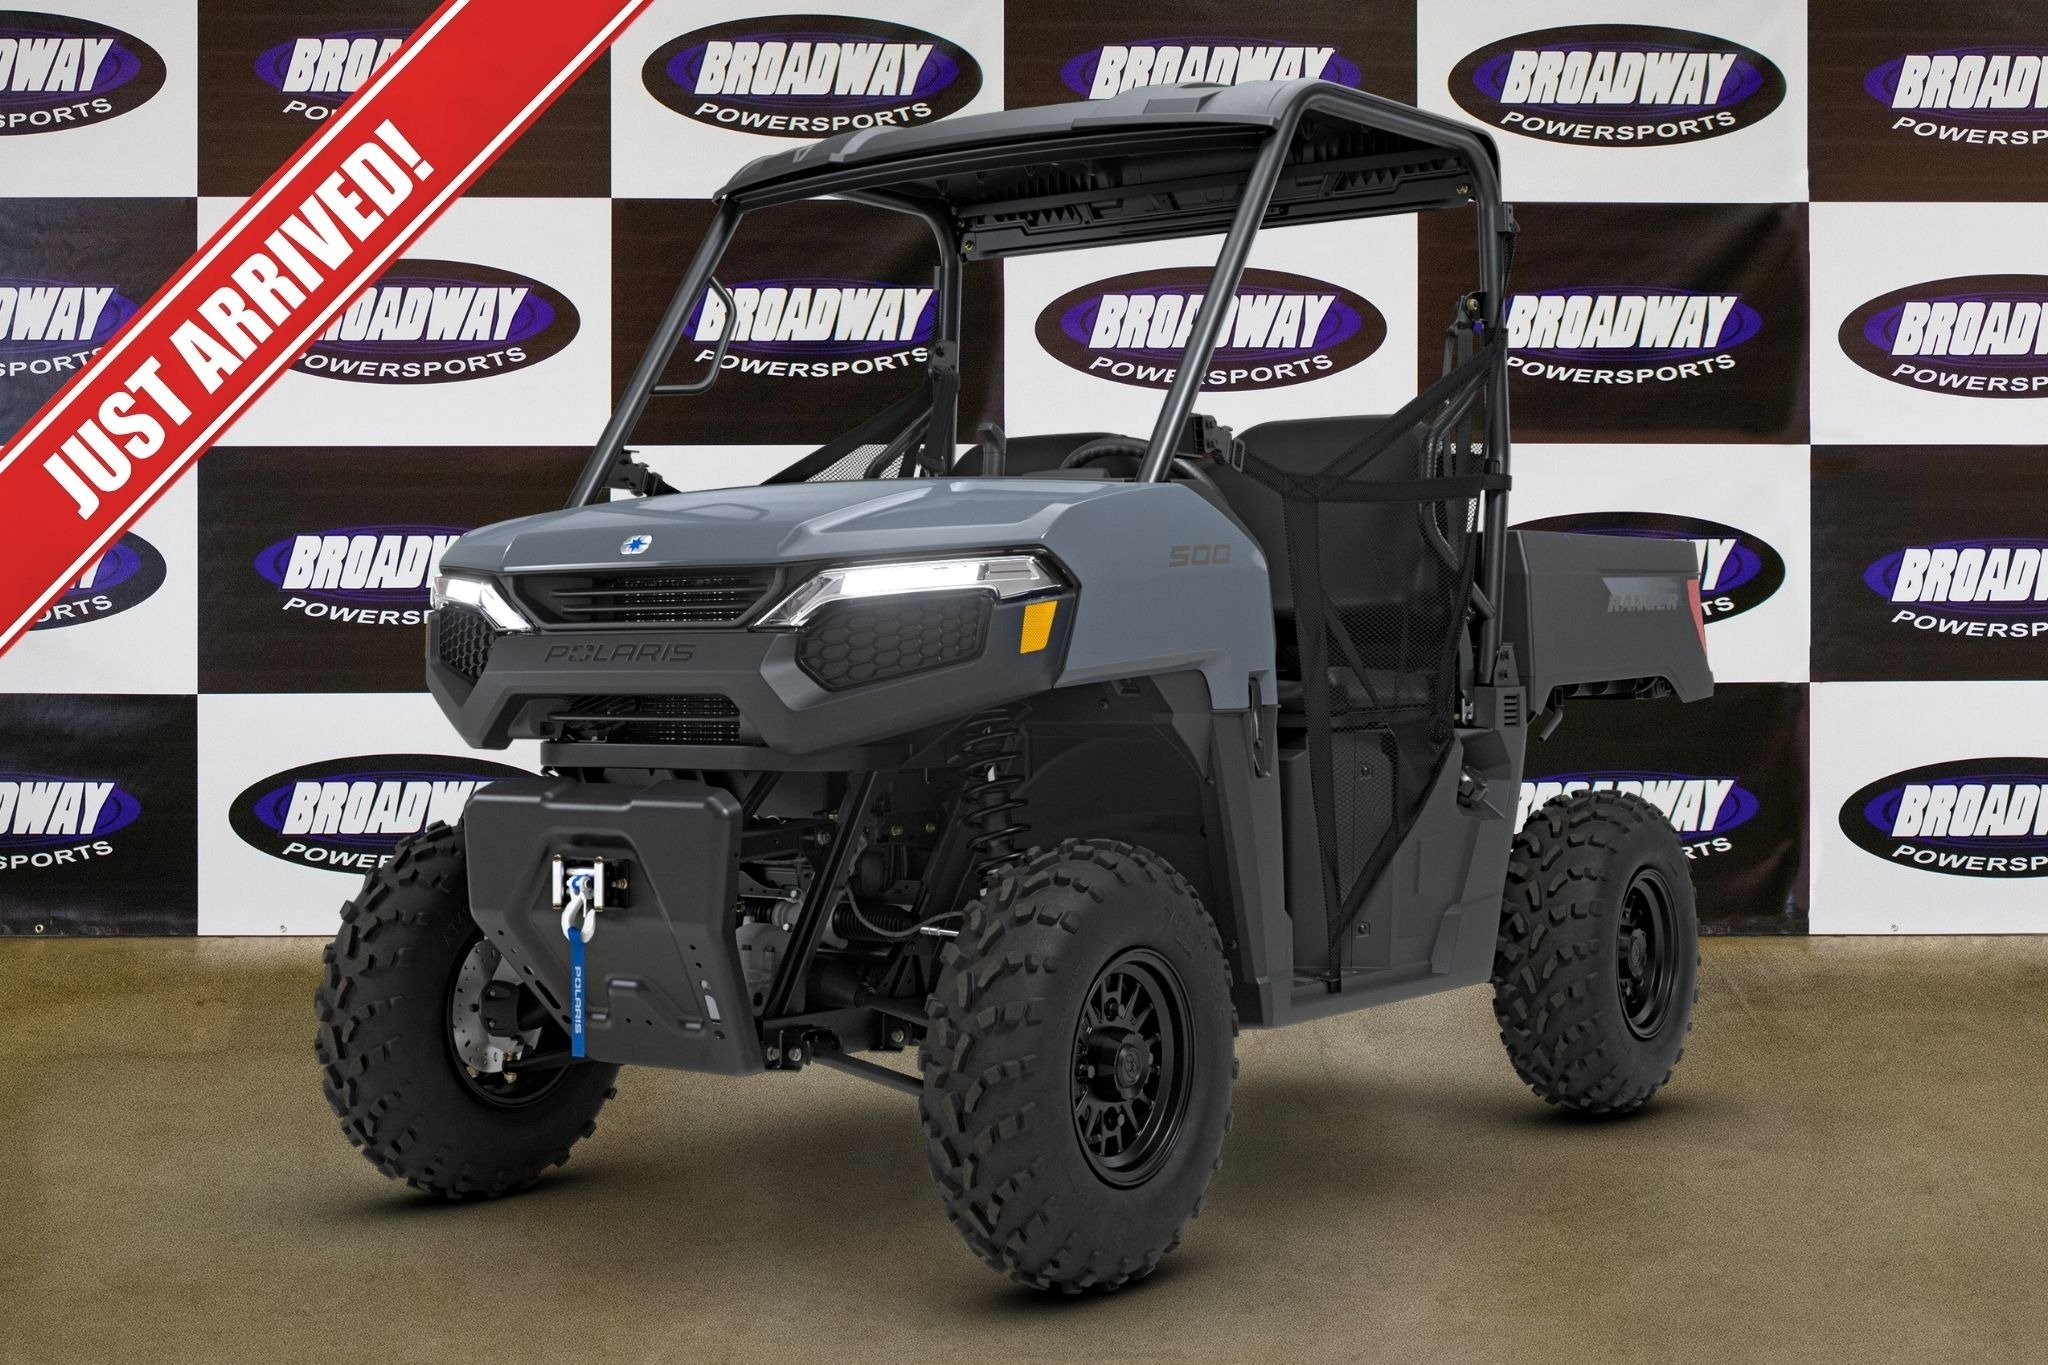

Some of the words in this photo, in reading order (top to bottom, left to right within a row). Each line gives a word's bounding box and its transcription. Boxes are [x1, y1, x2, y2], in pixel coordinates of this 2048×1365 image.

[694, 41, 933, 96] BROADWAY
[1089, 46, 1335, 99] BROADWAY
[1500, 51, 1737, 105] BROADWAY
[1892, 55, 2048, 109] BROAD
[694, 102, 932, 132] POWERSPORTS
[1500, 111, 1736, 140] POWERSPORTS
[694, 288, 933, 341] BROADWAY
[1506, 295, 1737, 348] BROADWAY
[1892, 302, 2048, 355] BROAD
[297, 347, 527, 378] OWERSPORTS
[694, 347, 928, 378] POWERSPORTS
[1089, 354, 1333, 385] POWESPORTS
[1507, 354, 1736, 384] POWERSPORTS
[1169, 544, 1231, 568] 500
[1892, 549, 2048, 602] BROAD
[544, 642, 697, 664] POLARIS
[282, 781, 494, 834] BROADW
[1892, 784, 2048, 837] BROAD
[574, 965, 583, 1035] POLARIS
